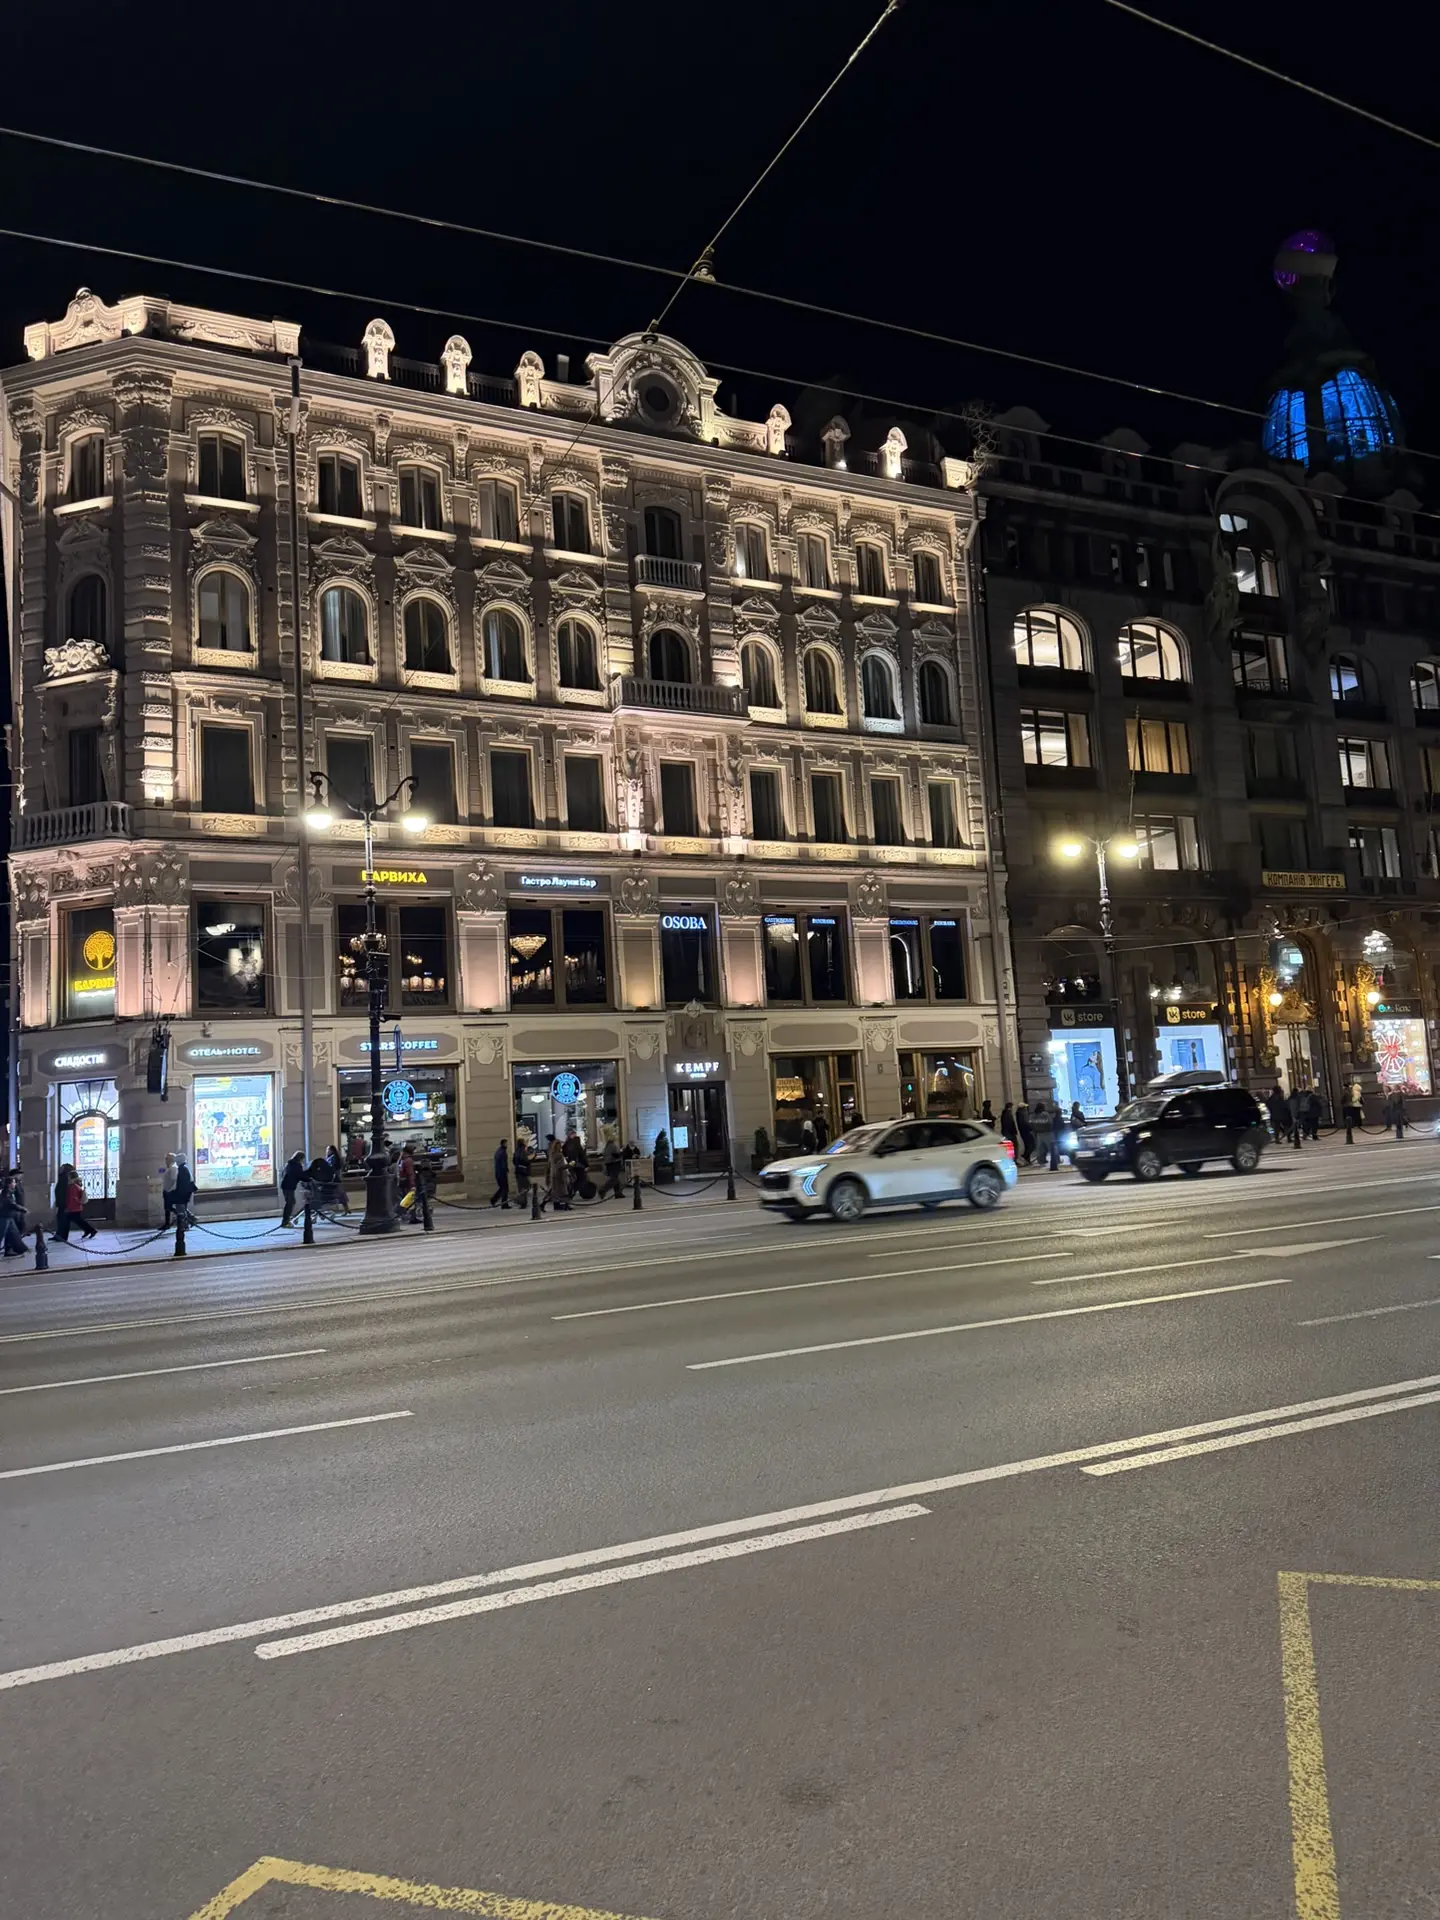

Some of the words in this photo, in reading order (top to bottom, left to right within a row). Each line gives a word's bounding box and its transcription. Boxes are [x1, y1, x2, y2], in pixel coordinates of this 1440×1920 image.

[521, 876, 551, 887] Гастро
[579, 877, 597, 889] Бар
[662, 915, 708, 930] OSOBA
[1077, 1011, 1104, 1022] store
[1181, 1009, 1206, 1020] store
[226, 1046, 261, 1056] HOTEL
[360, 1041, 396, 1052] STRS
[675, 1061, 720, 1073] KEMPF
